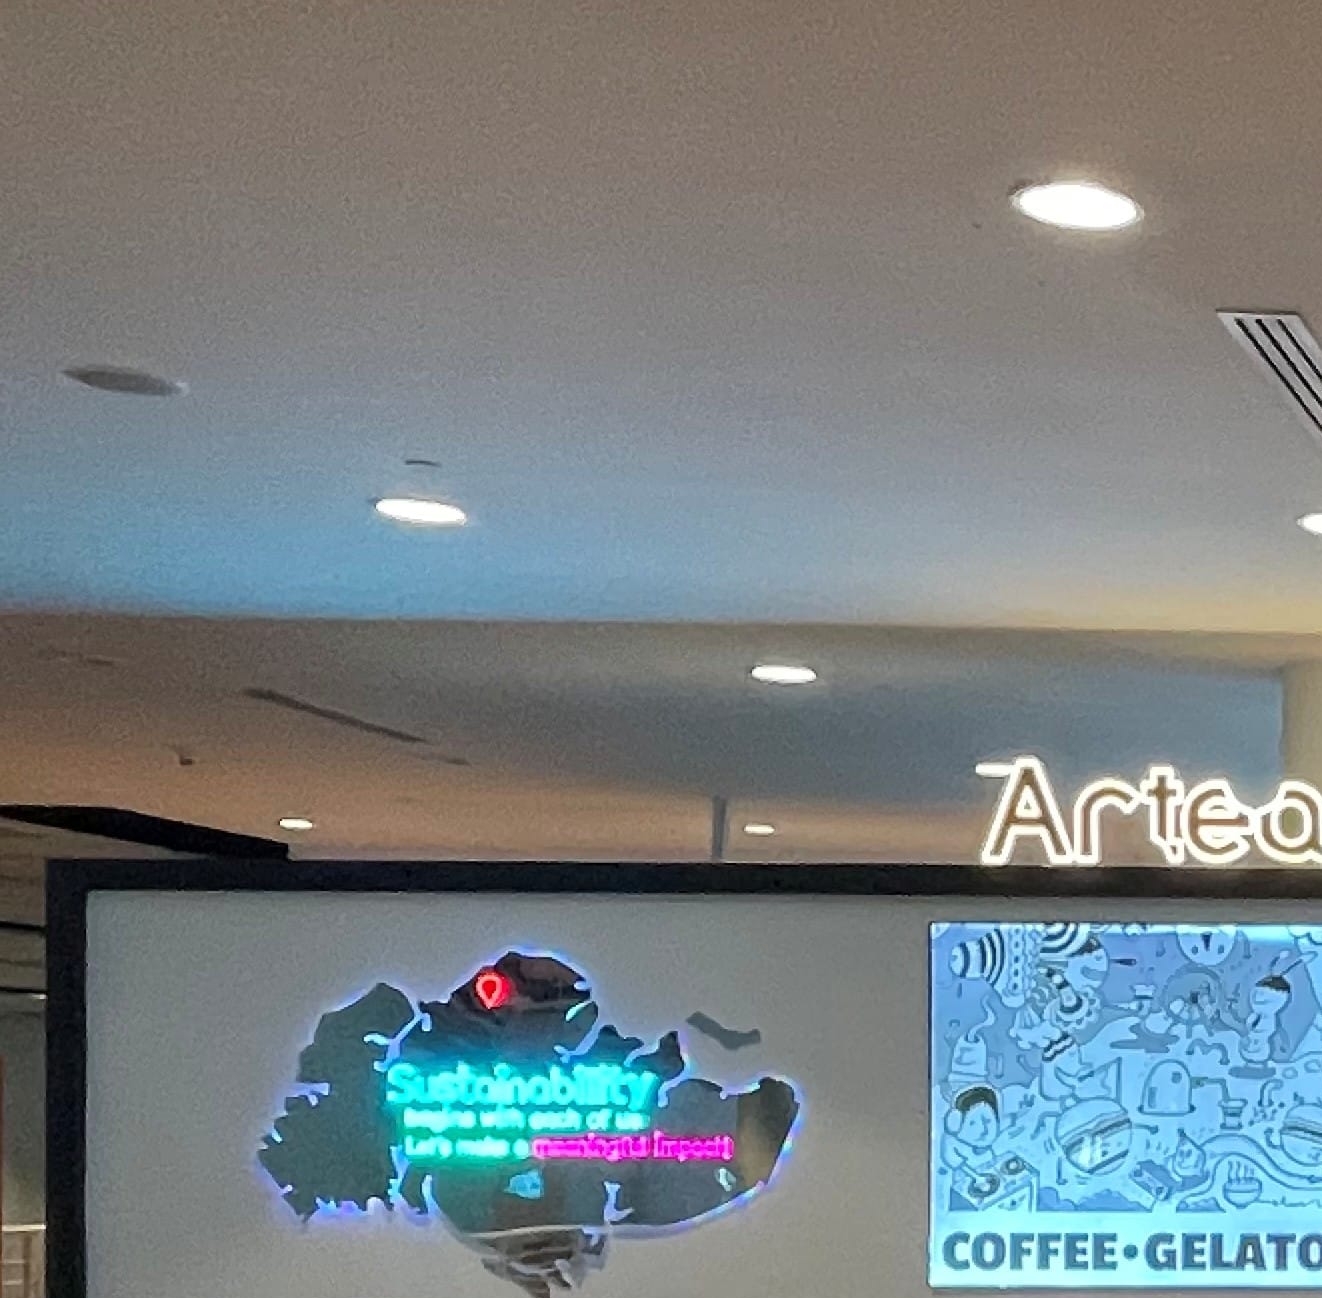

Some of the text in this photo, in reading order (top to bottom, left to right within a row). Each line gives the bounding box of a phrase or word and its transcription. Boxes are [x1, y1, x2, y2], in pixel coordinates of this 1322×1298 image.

[386, 1062, 657, 1110] Sustainability
[480, 1107, 525, 1129] with
[529, 1108, 581, 1130] each
[586, 1108, 612, 1130] of
[512, 1139, 530, 1158] a
[532, 1134, 650, 1160] meaningful
[942, 1231, 1119, 1272] COFFEE
